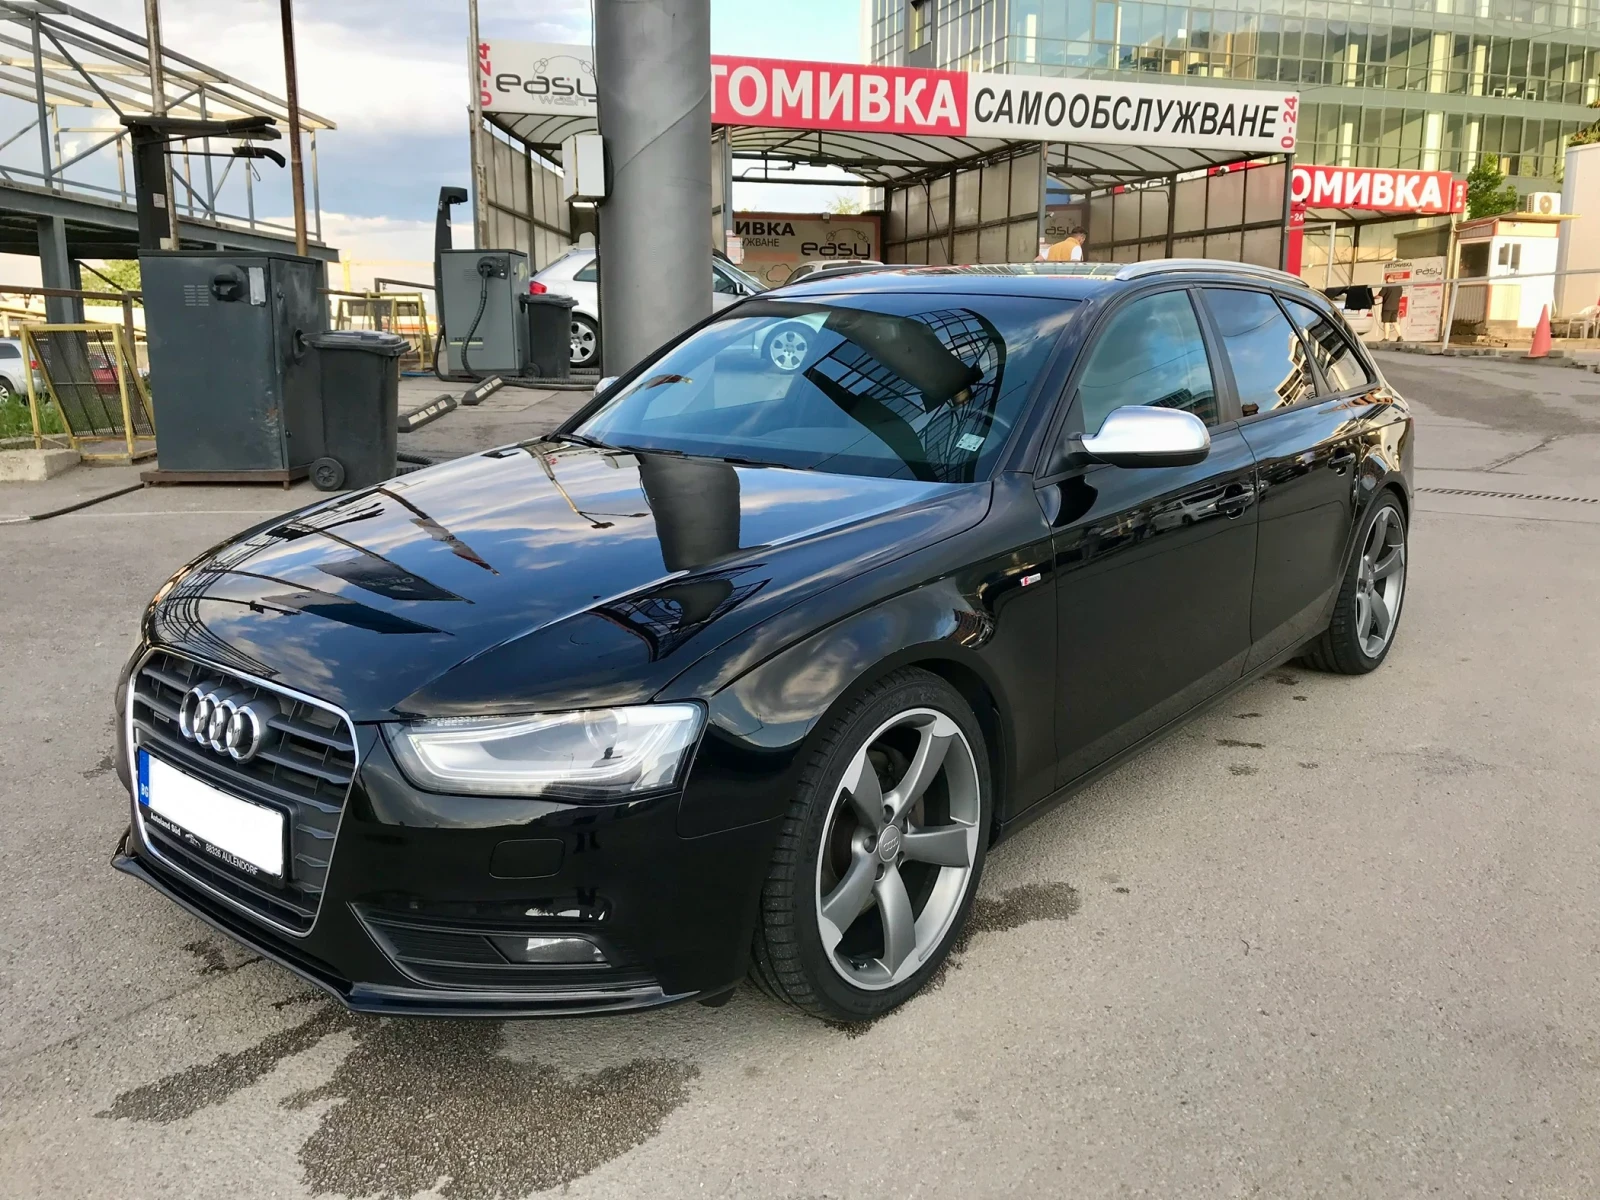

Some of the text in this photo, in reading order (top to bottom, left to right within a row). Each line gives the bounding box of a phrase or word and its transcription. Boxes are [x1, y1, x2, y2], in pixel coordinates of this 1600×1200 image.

[538, 94, 588, 107] wash
[974, 87, 1279, 138] САМООБСЛУЖВАНЕ
[1280, 95, 1298, 149] 0-24
[1291, 168, 1443, 208] ОМИВКА
[735, 221, 796, 237] ИВКА
[801, 242, 871, 260] easy
[1415, 267, 1443, 276] easy
[140, 783, 149, 798] BG
[221, 851, 259, 876] AULENDORF
